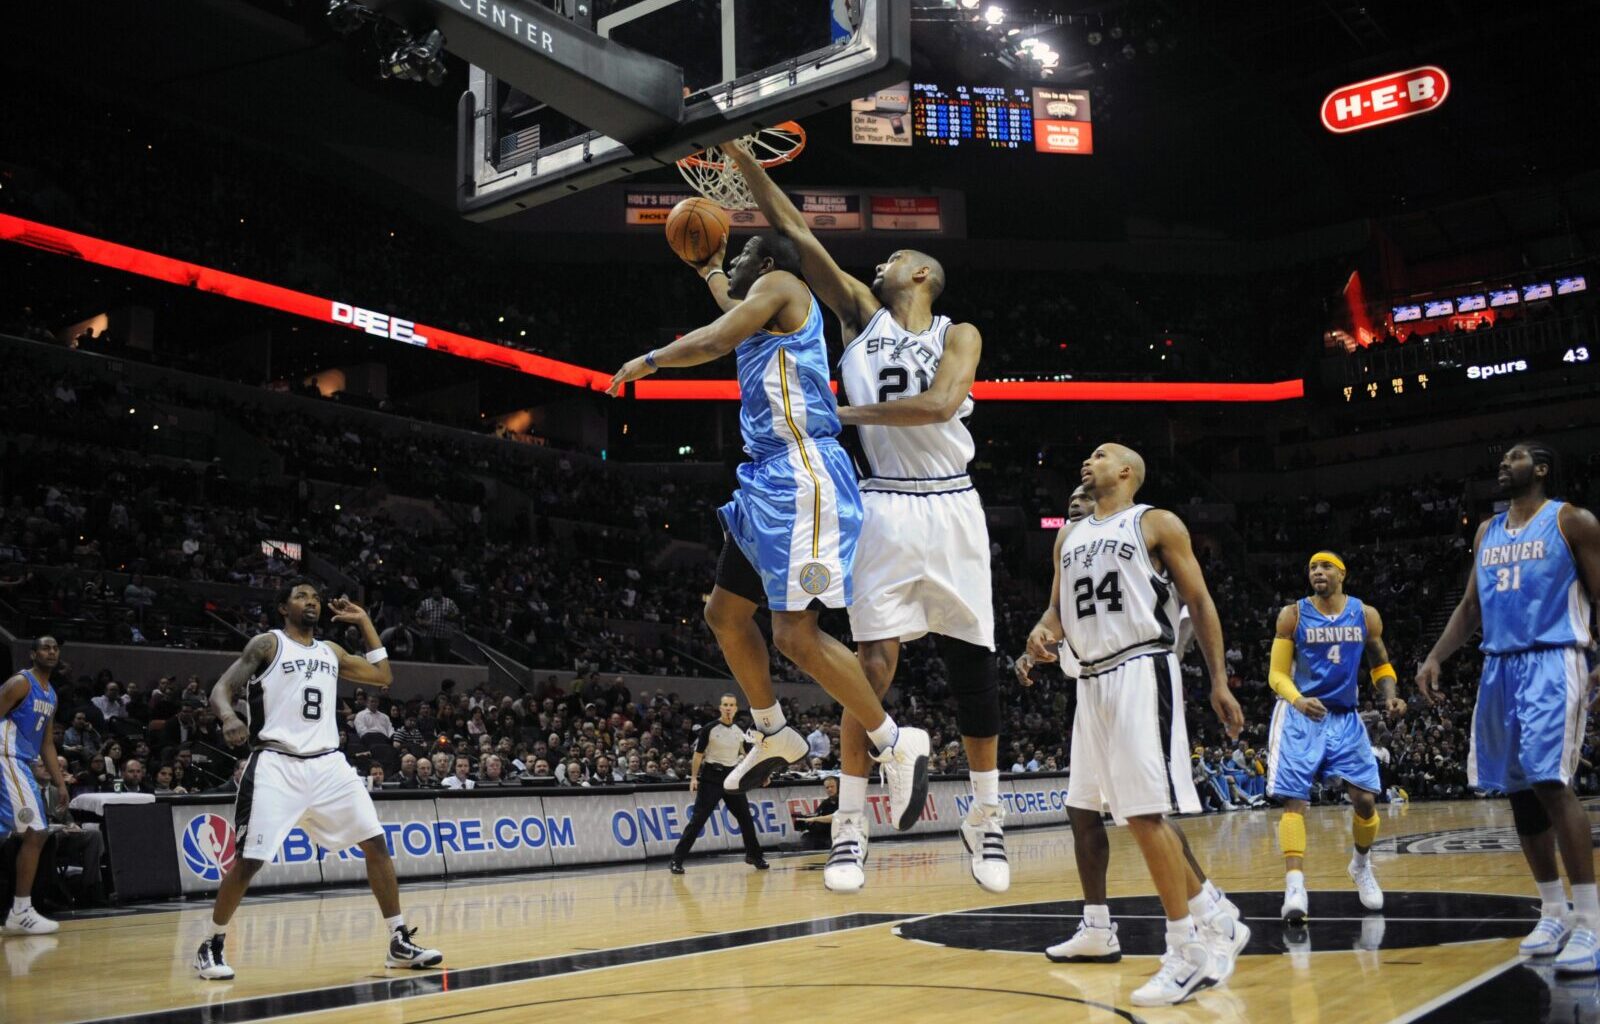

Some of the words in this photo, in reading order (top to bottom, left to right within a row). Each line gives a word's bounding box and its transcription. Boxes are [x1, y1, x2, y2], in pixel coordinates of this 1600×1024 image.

[913, 83, 938, 91] SPURS
[973, 87, 1005, 95] NUGGETS
[1039, 91, 1052, 99] This
[1059, 93, 1068, 102] my
[1335, 76, 1434, 122] H-E-B
[854, 125, 879, 133] Online
[868, 134, 883, 142] Your
[885, 135, 909, 143] Phone
[659, 194, 688, 205] HERO
[802, 203, 848, 212] CONNECTION
[804, 196, 817, 204] THE
[1467, 360, 1528, 379] Spurs
[1563, 347, 1589, 362] 43
[877, 366, 929, 403] 21
[1343, 386, 1353, 396] ST
[1367, 382, 1378, 391] AS
[1392, 378, 1403, 387] RB
[1418, 374, 1429, 382] BL
[1062, 538, 1136, 569] SPURS
[1481, 540, 1544, 567] DENVER
[1495, 565, 1520, 592] 31
[1073, 570, 1124, 620] 24
[1305, 626, 1363, 644] DENVER
[1326, 644, 1341, 665] 4
[281, 658, 337, 680] SPURS
[302, 686, 322, 721] 8
[611, 806, 682, 847] ONE
[271, 815, 576, 863] BTORE.COM
